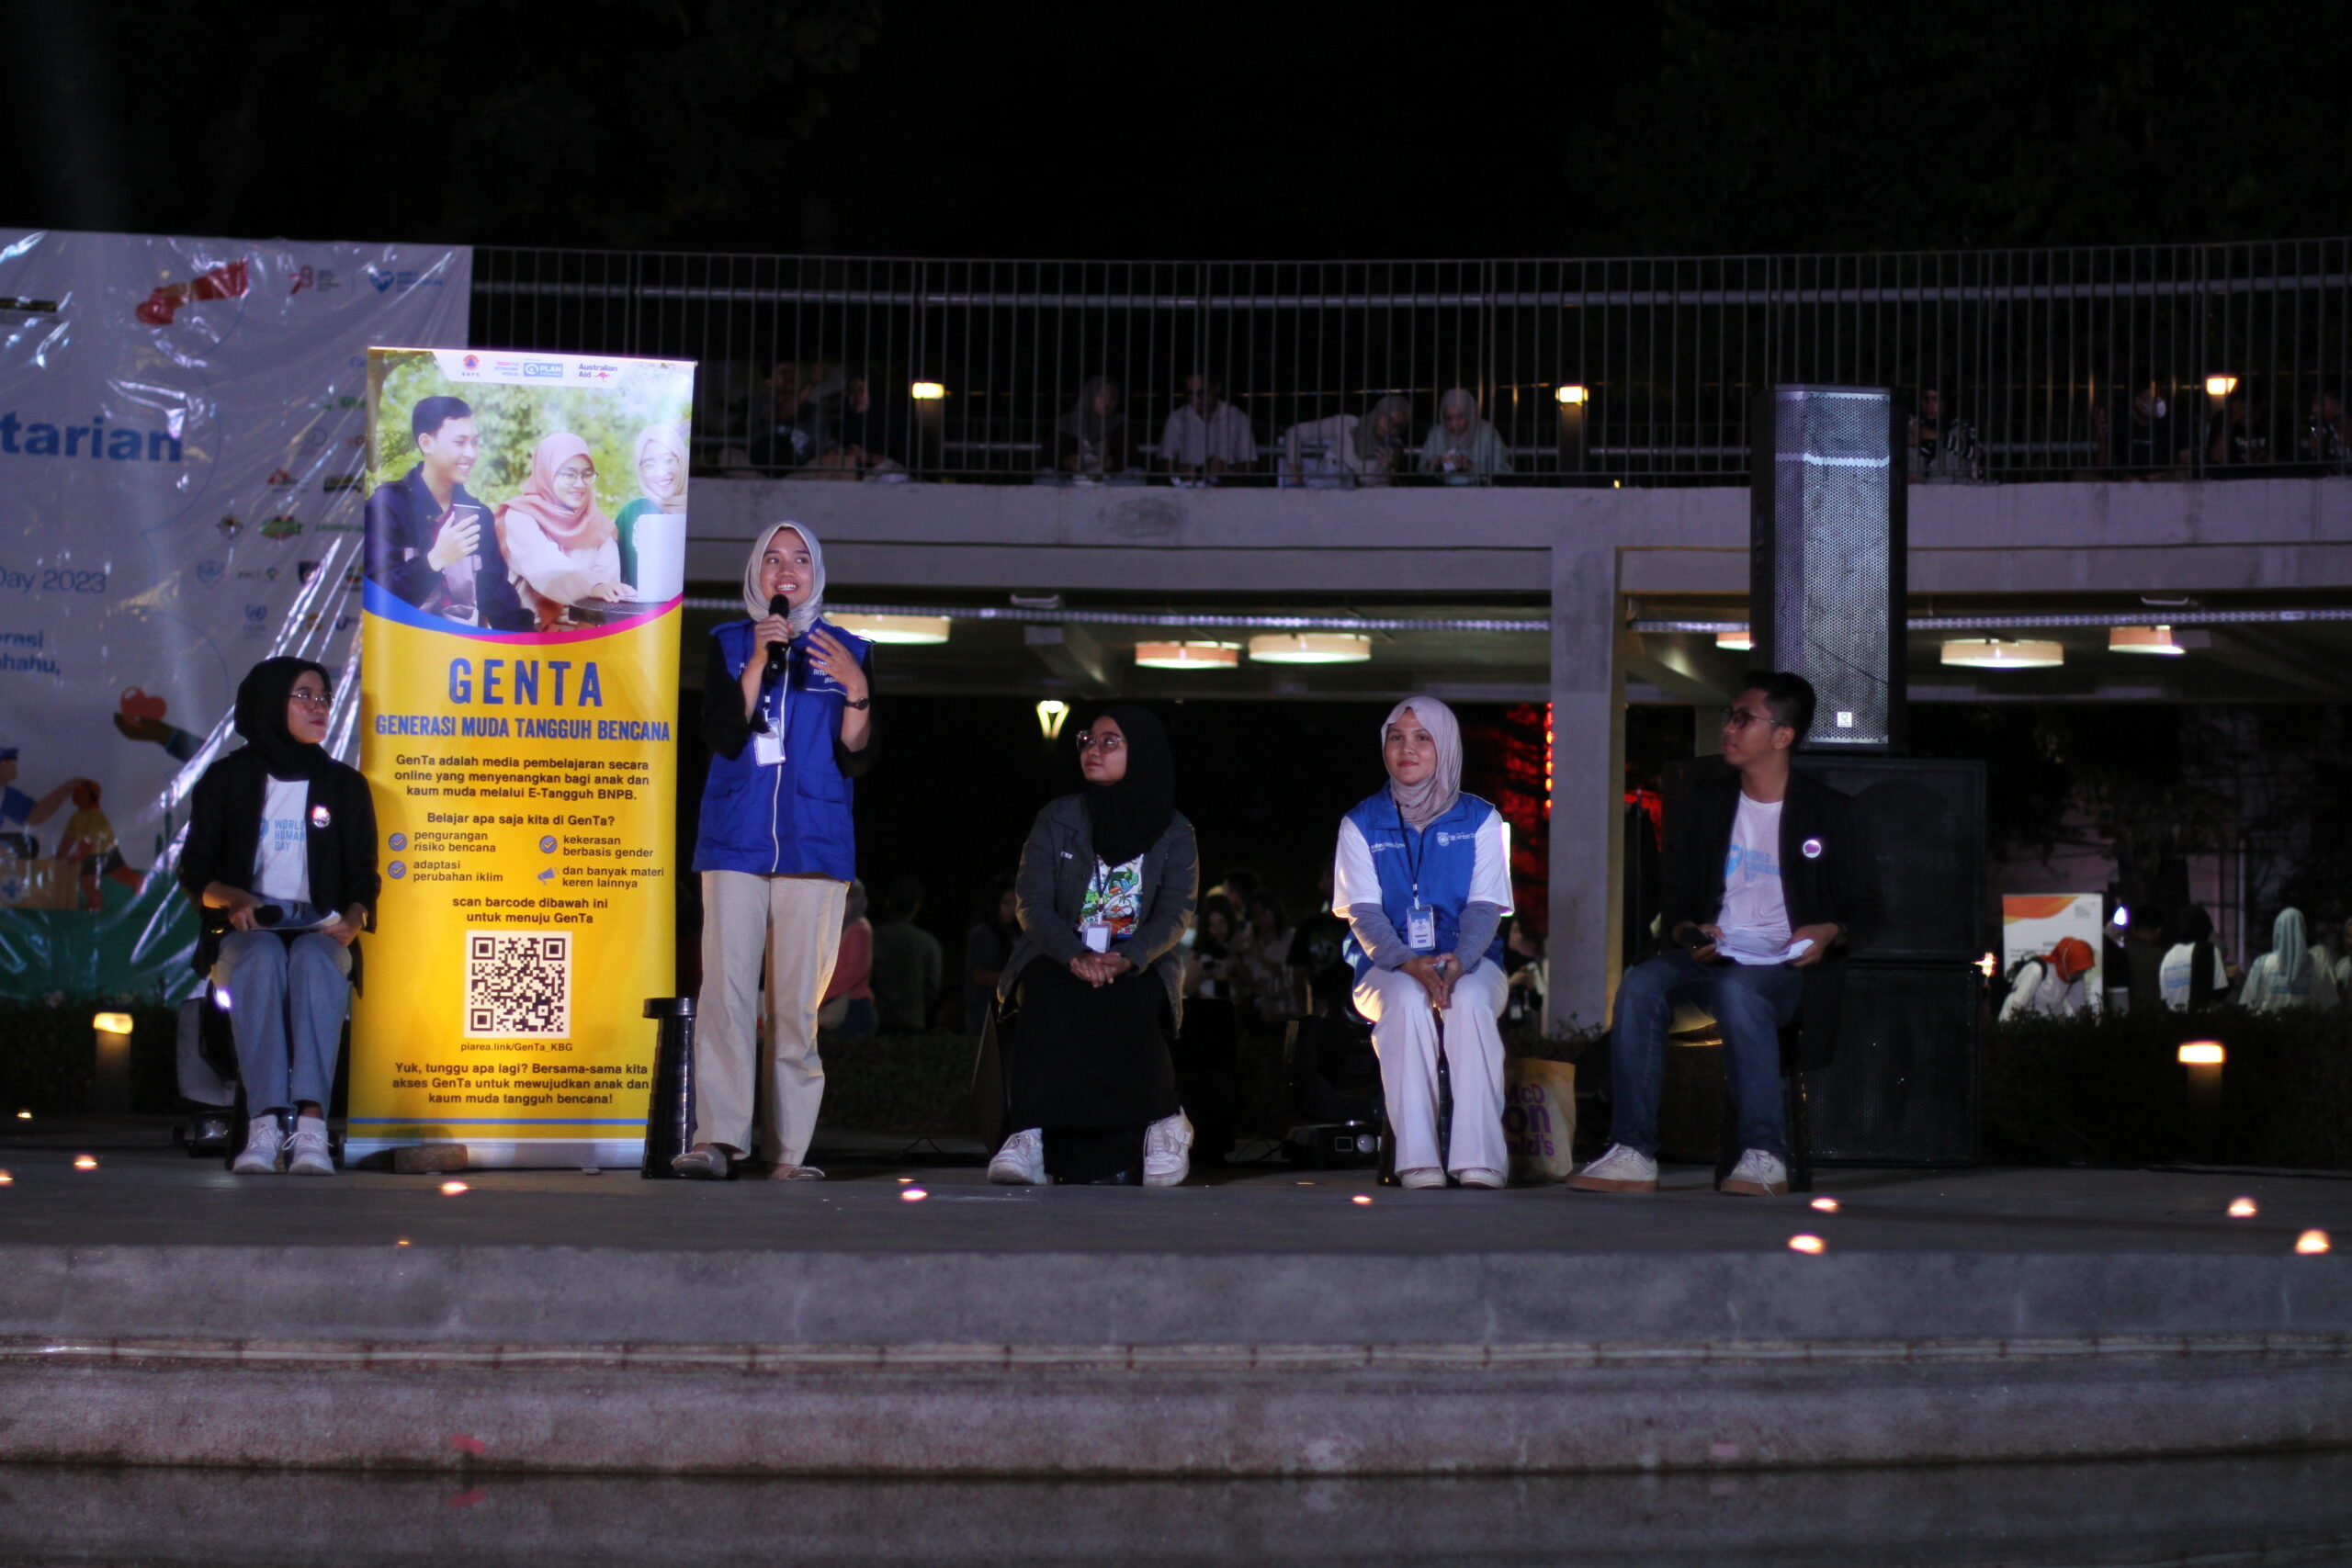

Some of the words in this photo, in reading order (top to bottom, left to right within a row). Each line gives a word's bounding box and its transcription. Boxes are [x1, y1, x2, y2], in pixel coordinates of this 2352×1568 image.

[539, 365, 561, 373] PLAN
[578, 364, 617, 372] Australian
[0, 411, 183, 462] tarian
[42, 568, 107, 593] 2023
[448, 658, 603, 707] GENTA
[376, 715, 456, 738] GENERASI
[461, 716, 510, 738] MUDA
[514, 718, 592, 739] TANGGUH
[597, 720, 669, 741] BENCANA
[396, 754, 435, 765] GenTa
[439, 756, 478, 766] adalah
[483, 757, 519, 767] media
[524, 758, 605, 771] pembelajaran
[609, 761, 648, 770] secara
[395, 771, 432, 780] online
[436, 773, 464, 784] yang
[469, 773, 560, 785] menyenangkan
[565, 773, 590, 786] bagi
[594, 774, 623, 784] anak
[628, 774, 649, 784] dan
[407, 785, 438, 796] kaum
[443, 786, 476, 796] muda
[481, 787, 524, 797] melalui
[528, 787, 594, 801] E-Tangguh
[598, 789, 636, 799] BNPB.
[428, 813, 469, 825] Belajar
[472, 816, 494, 826] apa
[499, 815, 523, 826] saja
[527, 815, 548, 825] kita
[553, 815, 563, 825] di
[568, 815, 615, 826] GenTa?
[415, 832, 487, 843] pengurangan
[564, 835, 620, 844] kekerasan
[275, 840, 292, 851] DAY
[414, 842, 445, 852] risiko
[449, 841, 495, 852] bencana
[563, 847, 611, 856] berbasis
[615, 848, 653, 859] gender
[413, 861, 459, 871] adaptasi
[563, 866, 582, 875] dan
[587, 866, 627, 877] banyak
[631, 868, 663, 876] materi
[413, 870, 471, 882] perubahan
[477, 873, 503, 881] iklim
[563, 878, 593, 886] keren
[597, 878, 638, 889] lainnya
[453, 898, 481, 907] scan
[486, 897, 535, 908] barcode
[538, 897, 589, 908] dibawah
[594, 898, 607, 908] ini
[467, 913, 501, 921] untuk
[506, 913, 549, 925] menuju
[554, 913, 593, 923] GenTa
[461, 1042, 572, 1053] piarea.link/GenTa_KBG
[396, 1063, 421, 1074] Yuk,
[425, 1064, 468, 1075] tunggu
[473, 1066, 493, 1075] apa
[499, 1064, 527, 1076] lagi?
[533, 1064, 622, 1074] Bersama-sama
[626, 1065, 648, 1074] kita
[392, 1078, 427, 1088] akses
[432, 1077, 470, 1088] GenTa
[476, 1079, 509, 1088] untuk
[514, 1078, 590, 1090] mewujudkan
[594, 1079, 623, 1089] anak
[627, 1079, 649, 1089] dan
[429, 1094, 461, 1102] kaum
[466, 1094, 499, 1103] muda
[503, 1094, 552, 1106] tangguh
[557, 1094, 612, 1104] bencana!
[1501, 1105, 1552, 1134] on
